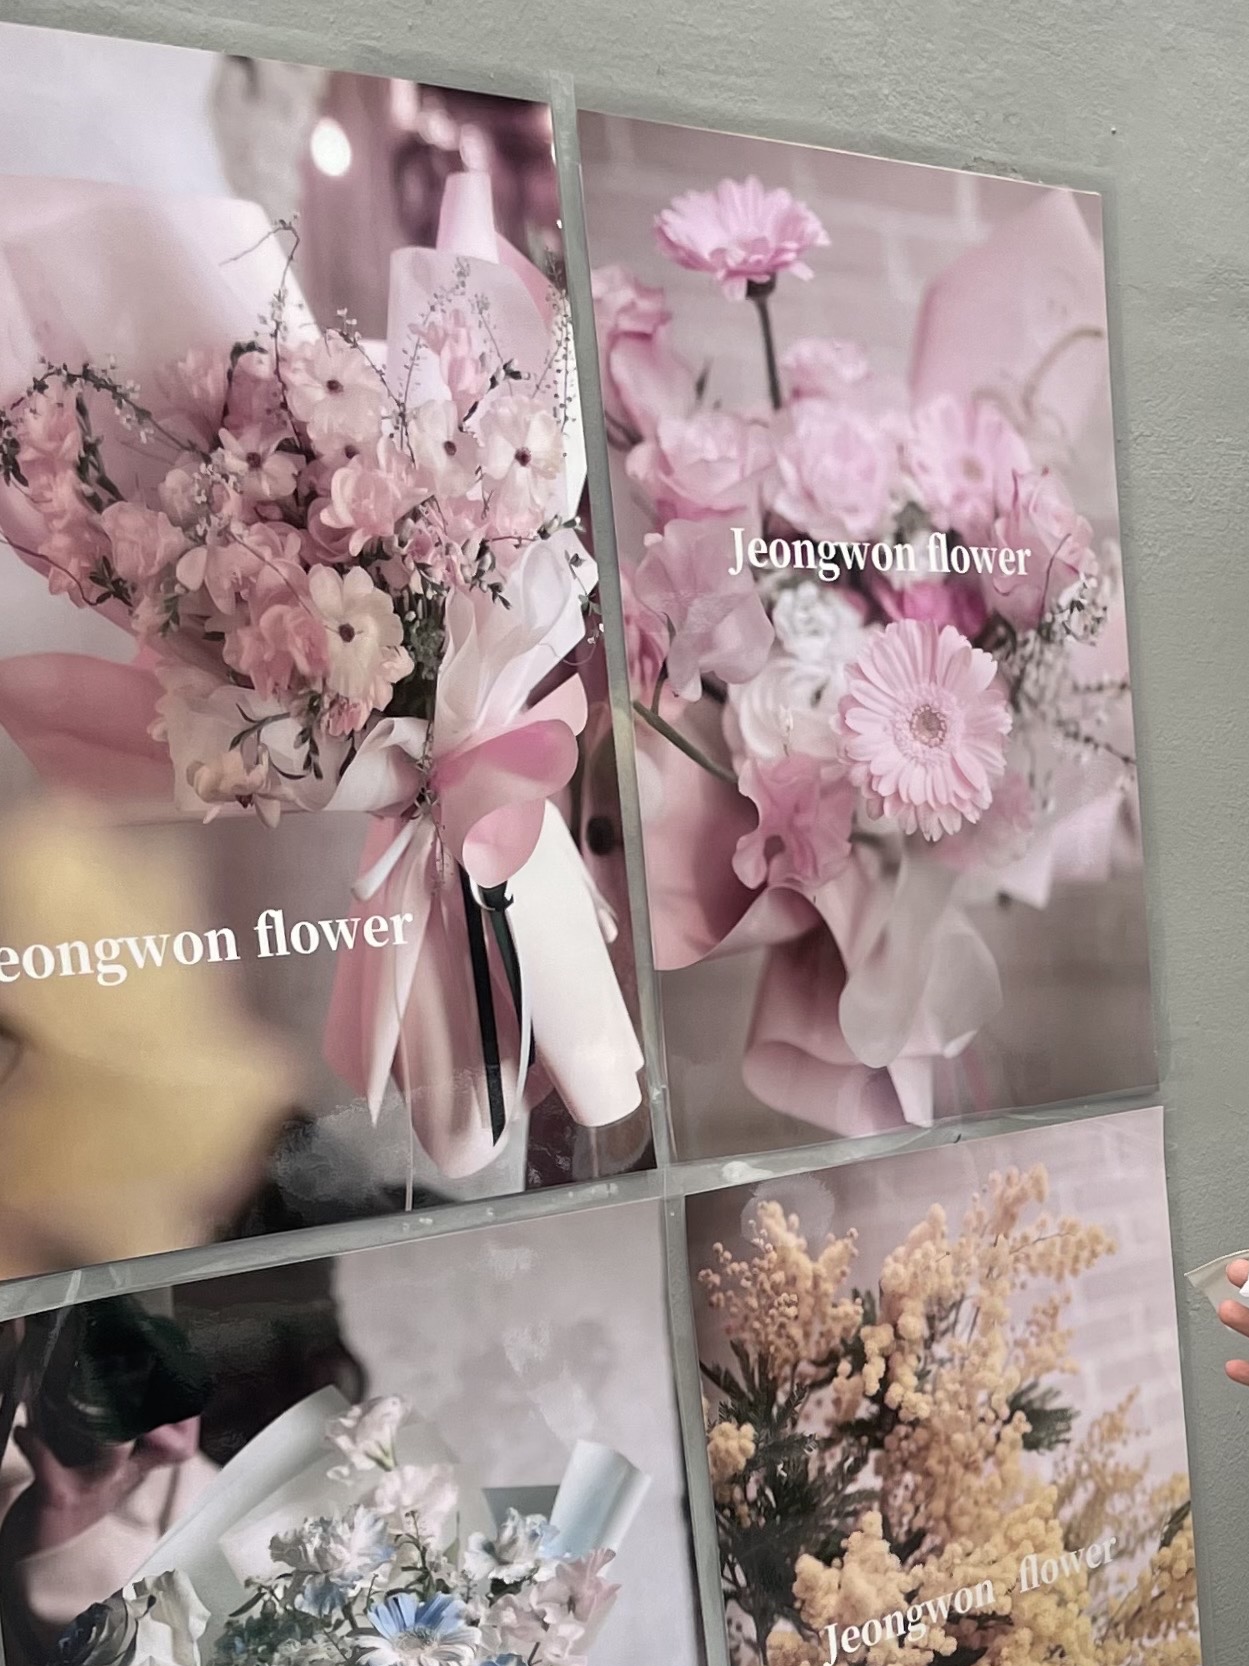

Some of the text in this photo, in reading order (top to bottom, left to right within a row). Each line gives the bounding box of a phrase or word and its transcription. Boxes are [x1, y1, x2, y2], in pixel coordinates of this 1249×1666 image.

[728, 527, 1032, 582] Jeongwon flower
[253, 908, 415, 958] flower
[1018, 1536, 1118, 1594] flower
